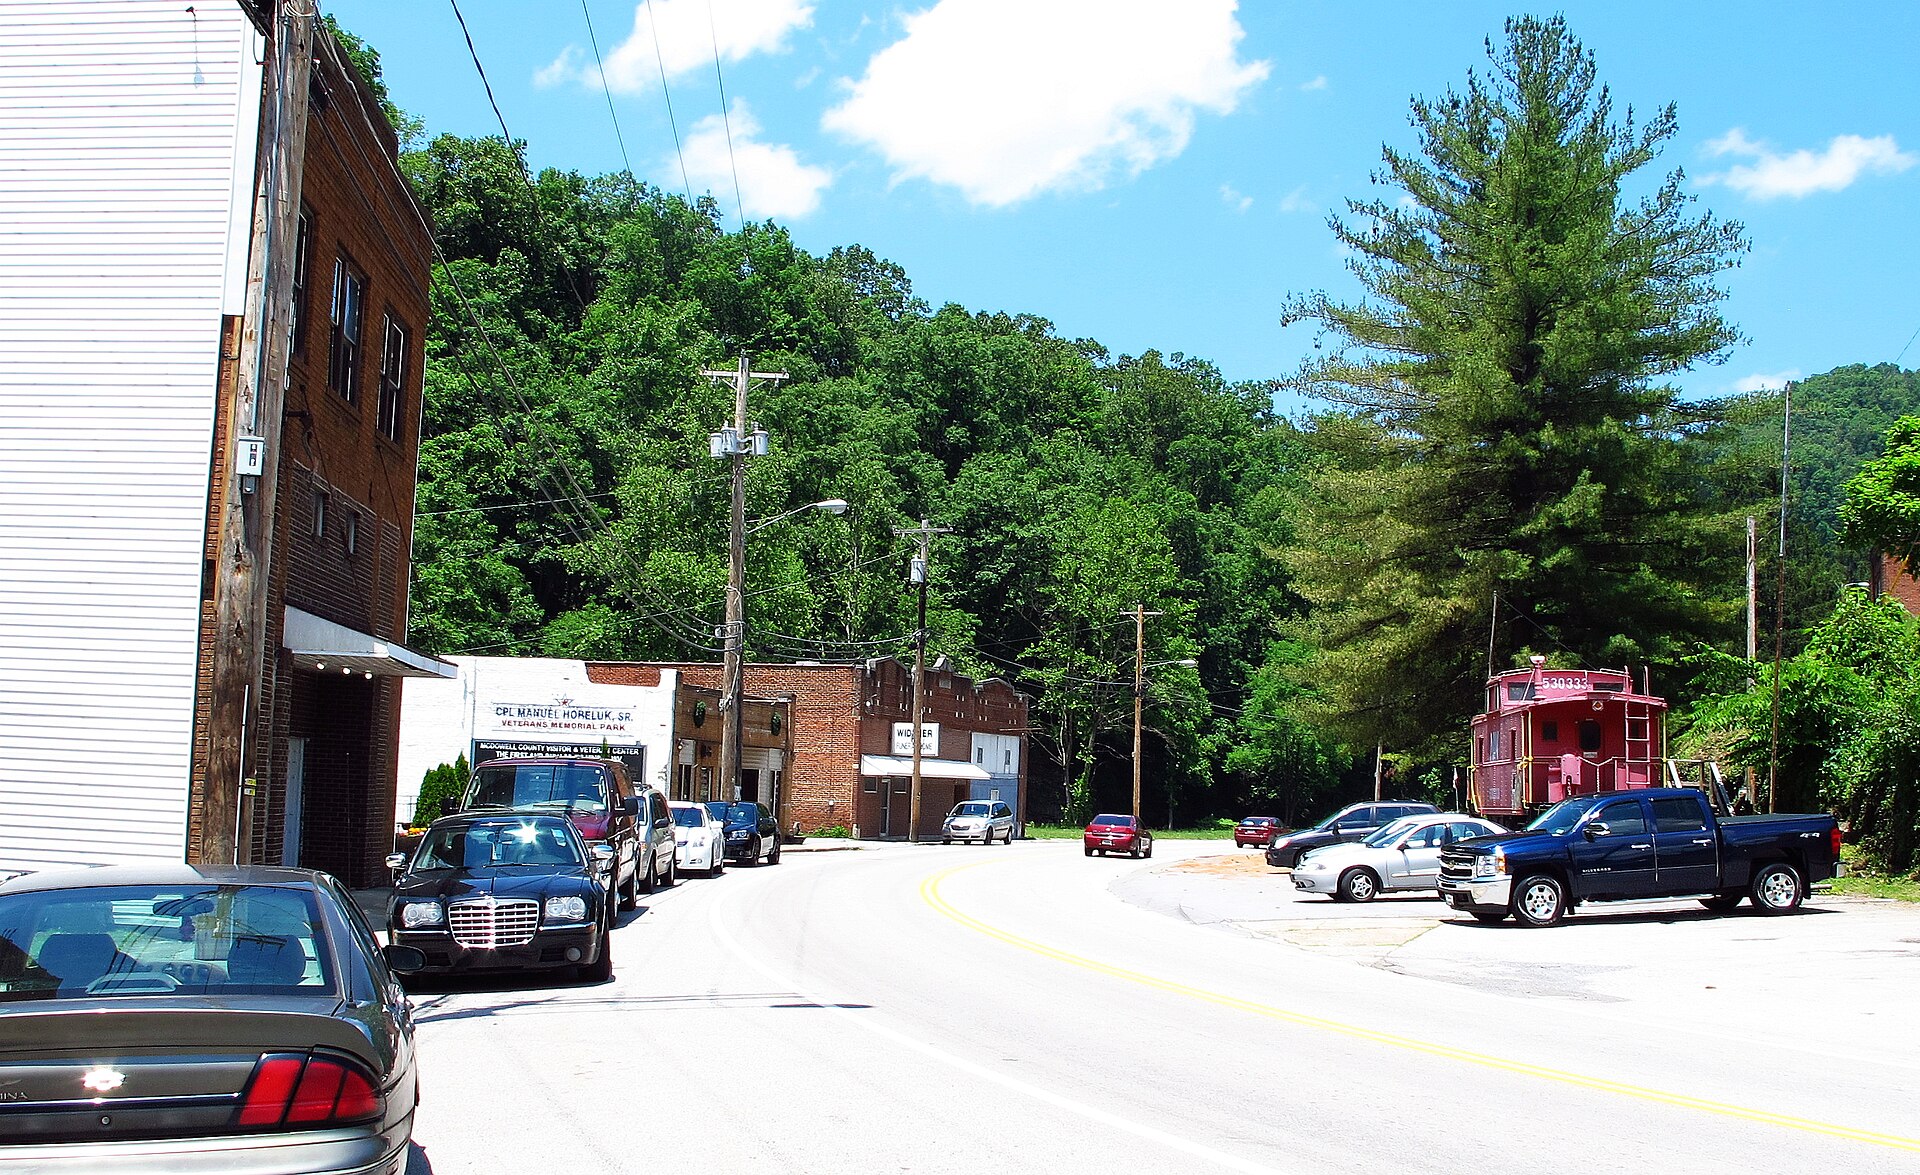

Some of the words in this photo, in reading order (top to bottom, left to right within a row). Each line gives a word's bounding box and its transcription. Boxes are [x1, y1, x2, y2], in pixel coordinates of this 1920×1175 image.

[1542, 677, 1588, 690] 530333
[495, 707, 514, 717] CPL
[517, 708, 560, 719] MANUEL
[618, 712, 634, 722] SR.
[501, 720, 548, 728] VETERANS
[551, 722, 597, 730] MEMORIAL
[601, 723, 625, 731] PARK
[897, 729, 933, 738] WIDER
[496, 750, 509, 759] THE
[518, 744, 545, 752] COUNTY
[546, 745, 572, 753] VISITOR
[612, 747, 639, 756] CENTER
